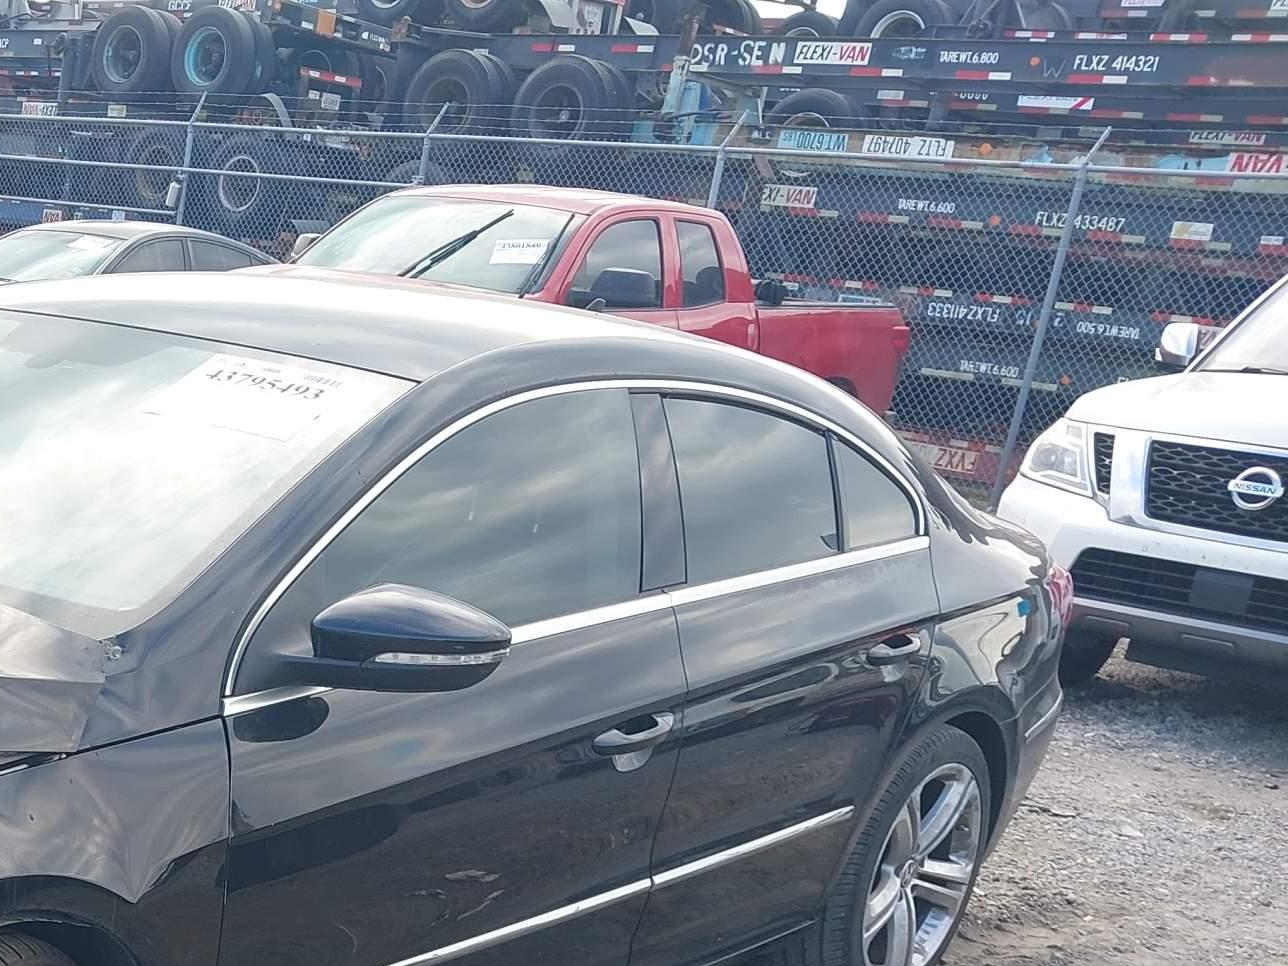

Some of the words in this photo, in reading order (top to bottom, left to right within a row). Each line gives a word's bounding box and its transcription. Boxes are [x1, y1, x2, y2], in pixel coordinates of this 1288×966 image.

[797, 43, 869, 62] FLEXI-VAN
[1073, 55, 1108, 71] FLXZ
[1112, 55, 1160, 72] 414321
[1035, 211, 1068, 228] FLXZ
[1074, 214, 1125, 231] 433487
[205, 369, 326, 400] 43795493
[1233, 482, 1278, 496] NISSAN
